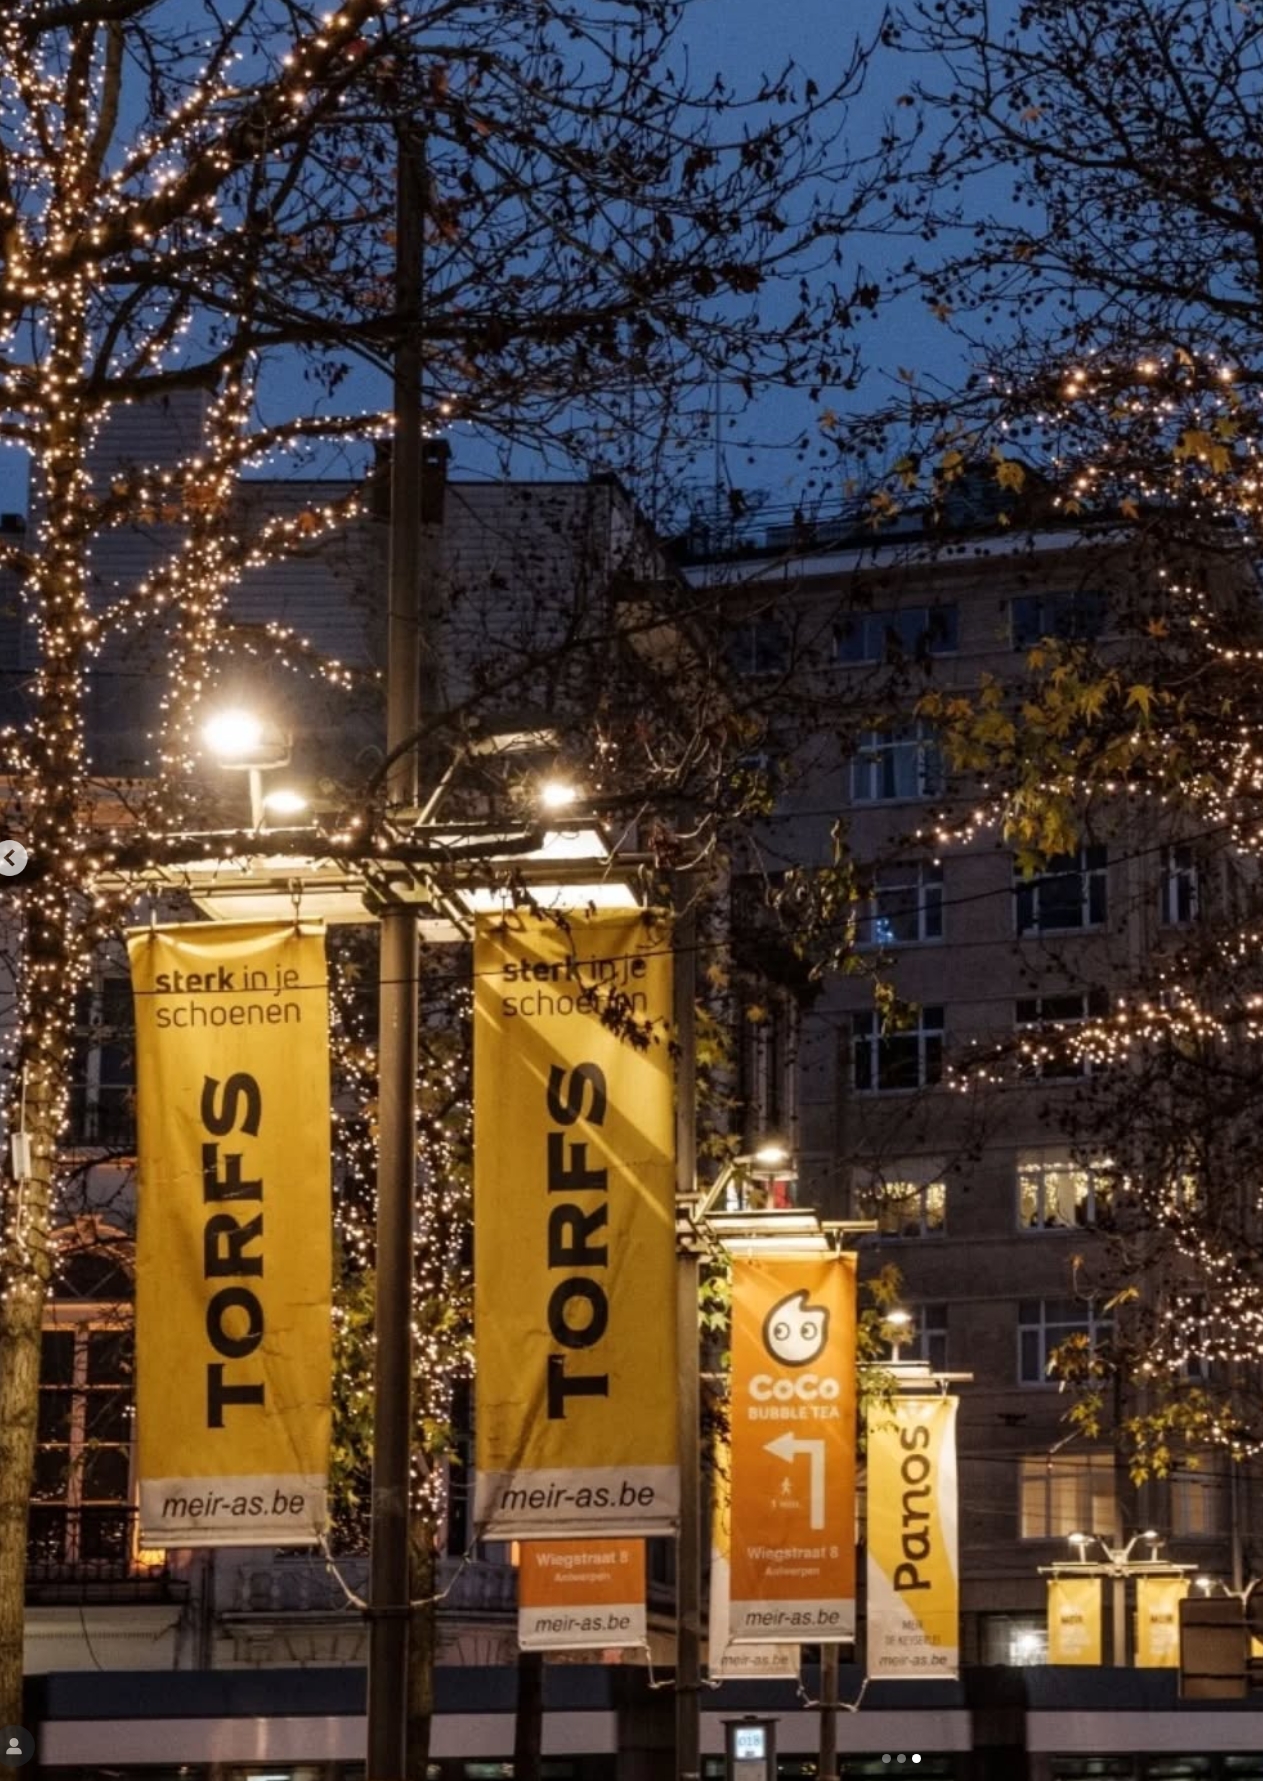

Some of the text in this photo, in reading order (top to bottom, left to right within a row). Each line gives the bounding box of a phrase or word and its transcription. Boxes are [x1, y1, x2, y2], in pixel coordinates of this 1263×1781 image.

[155, 963, 299, 997] sterk in je
[502, 954, 576, 982] sterk
[156, 1000, 301, 1028] schoenen
[200, 1072, 265, 1428] TORFS
[546, 1062, 609, 1420] TORFS
[748, 1405, 840, 1420] BUBBLE TEA
[161, 1488, 305, 1518] meir-as.be
[500, 1480, 655, 1510] meir-as.be
[893, 1425, 932, 1592] Panos
[829, 1546, 839, 1559] 8
[534, 1614, 630, 1633] meir-as.be
[745, 1609, 840, 1626] meir-as.be
